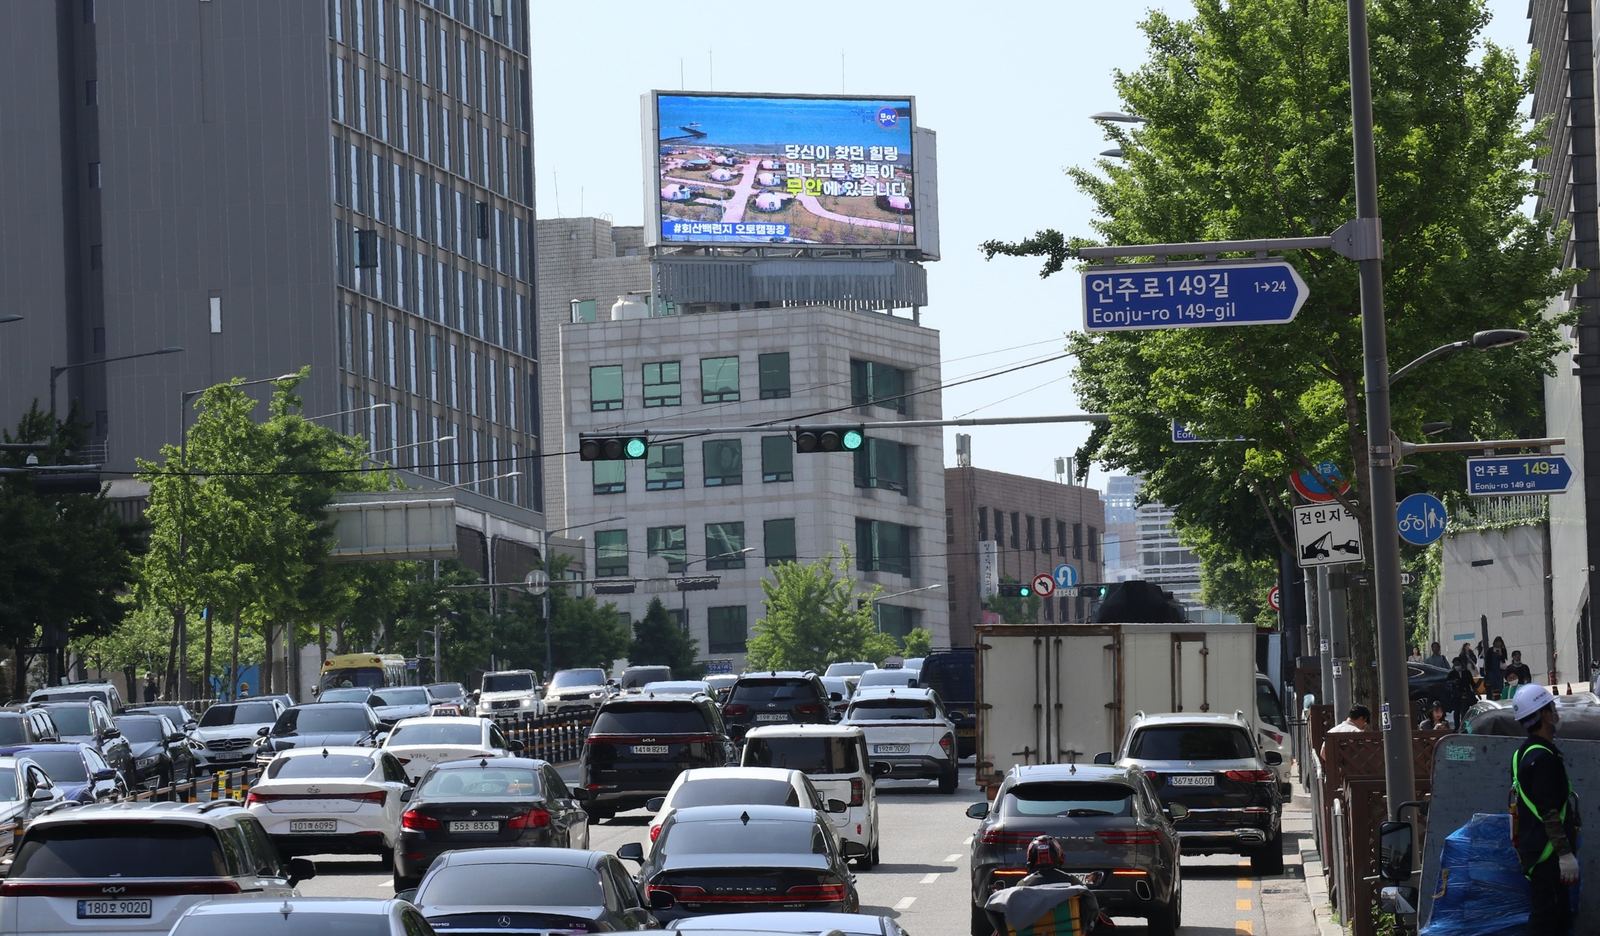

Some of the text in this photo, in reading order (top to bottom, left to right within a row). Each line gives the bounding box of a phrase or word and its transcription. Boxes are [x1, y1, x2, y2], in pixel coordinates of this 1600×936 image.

[785, 144, 898, 161] 당신이 찾던 힐링
[786, 162, 895, 179] 만나고픈 행복이
[786, 178, 906, 197] 무안에 있습니다
[736, 224, 785, 234] 오토캠핑장
[1092, 272, 1229, 303] 언주로149길
[1092, 302, 1236, 325] Eonju-ro 149-gil
[1474, 462, 1559, 476] 언주로 149길
[120, 902, 148, 913] 9020
